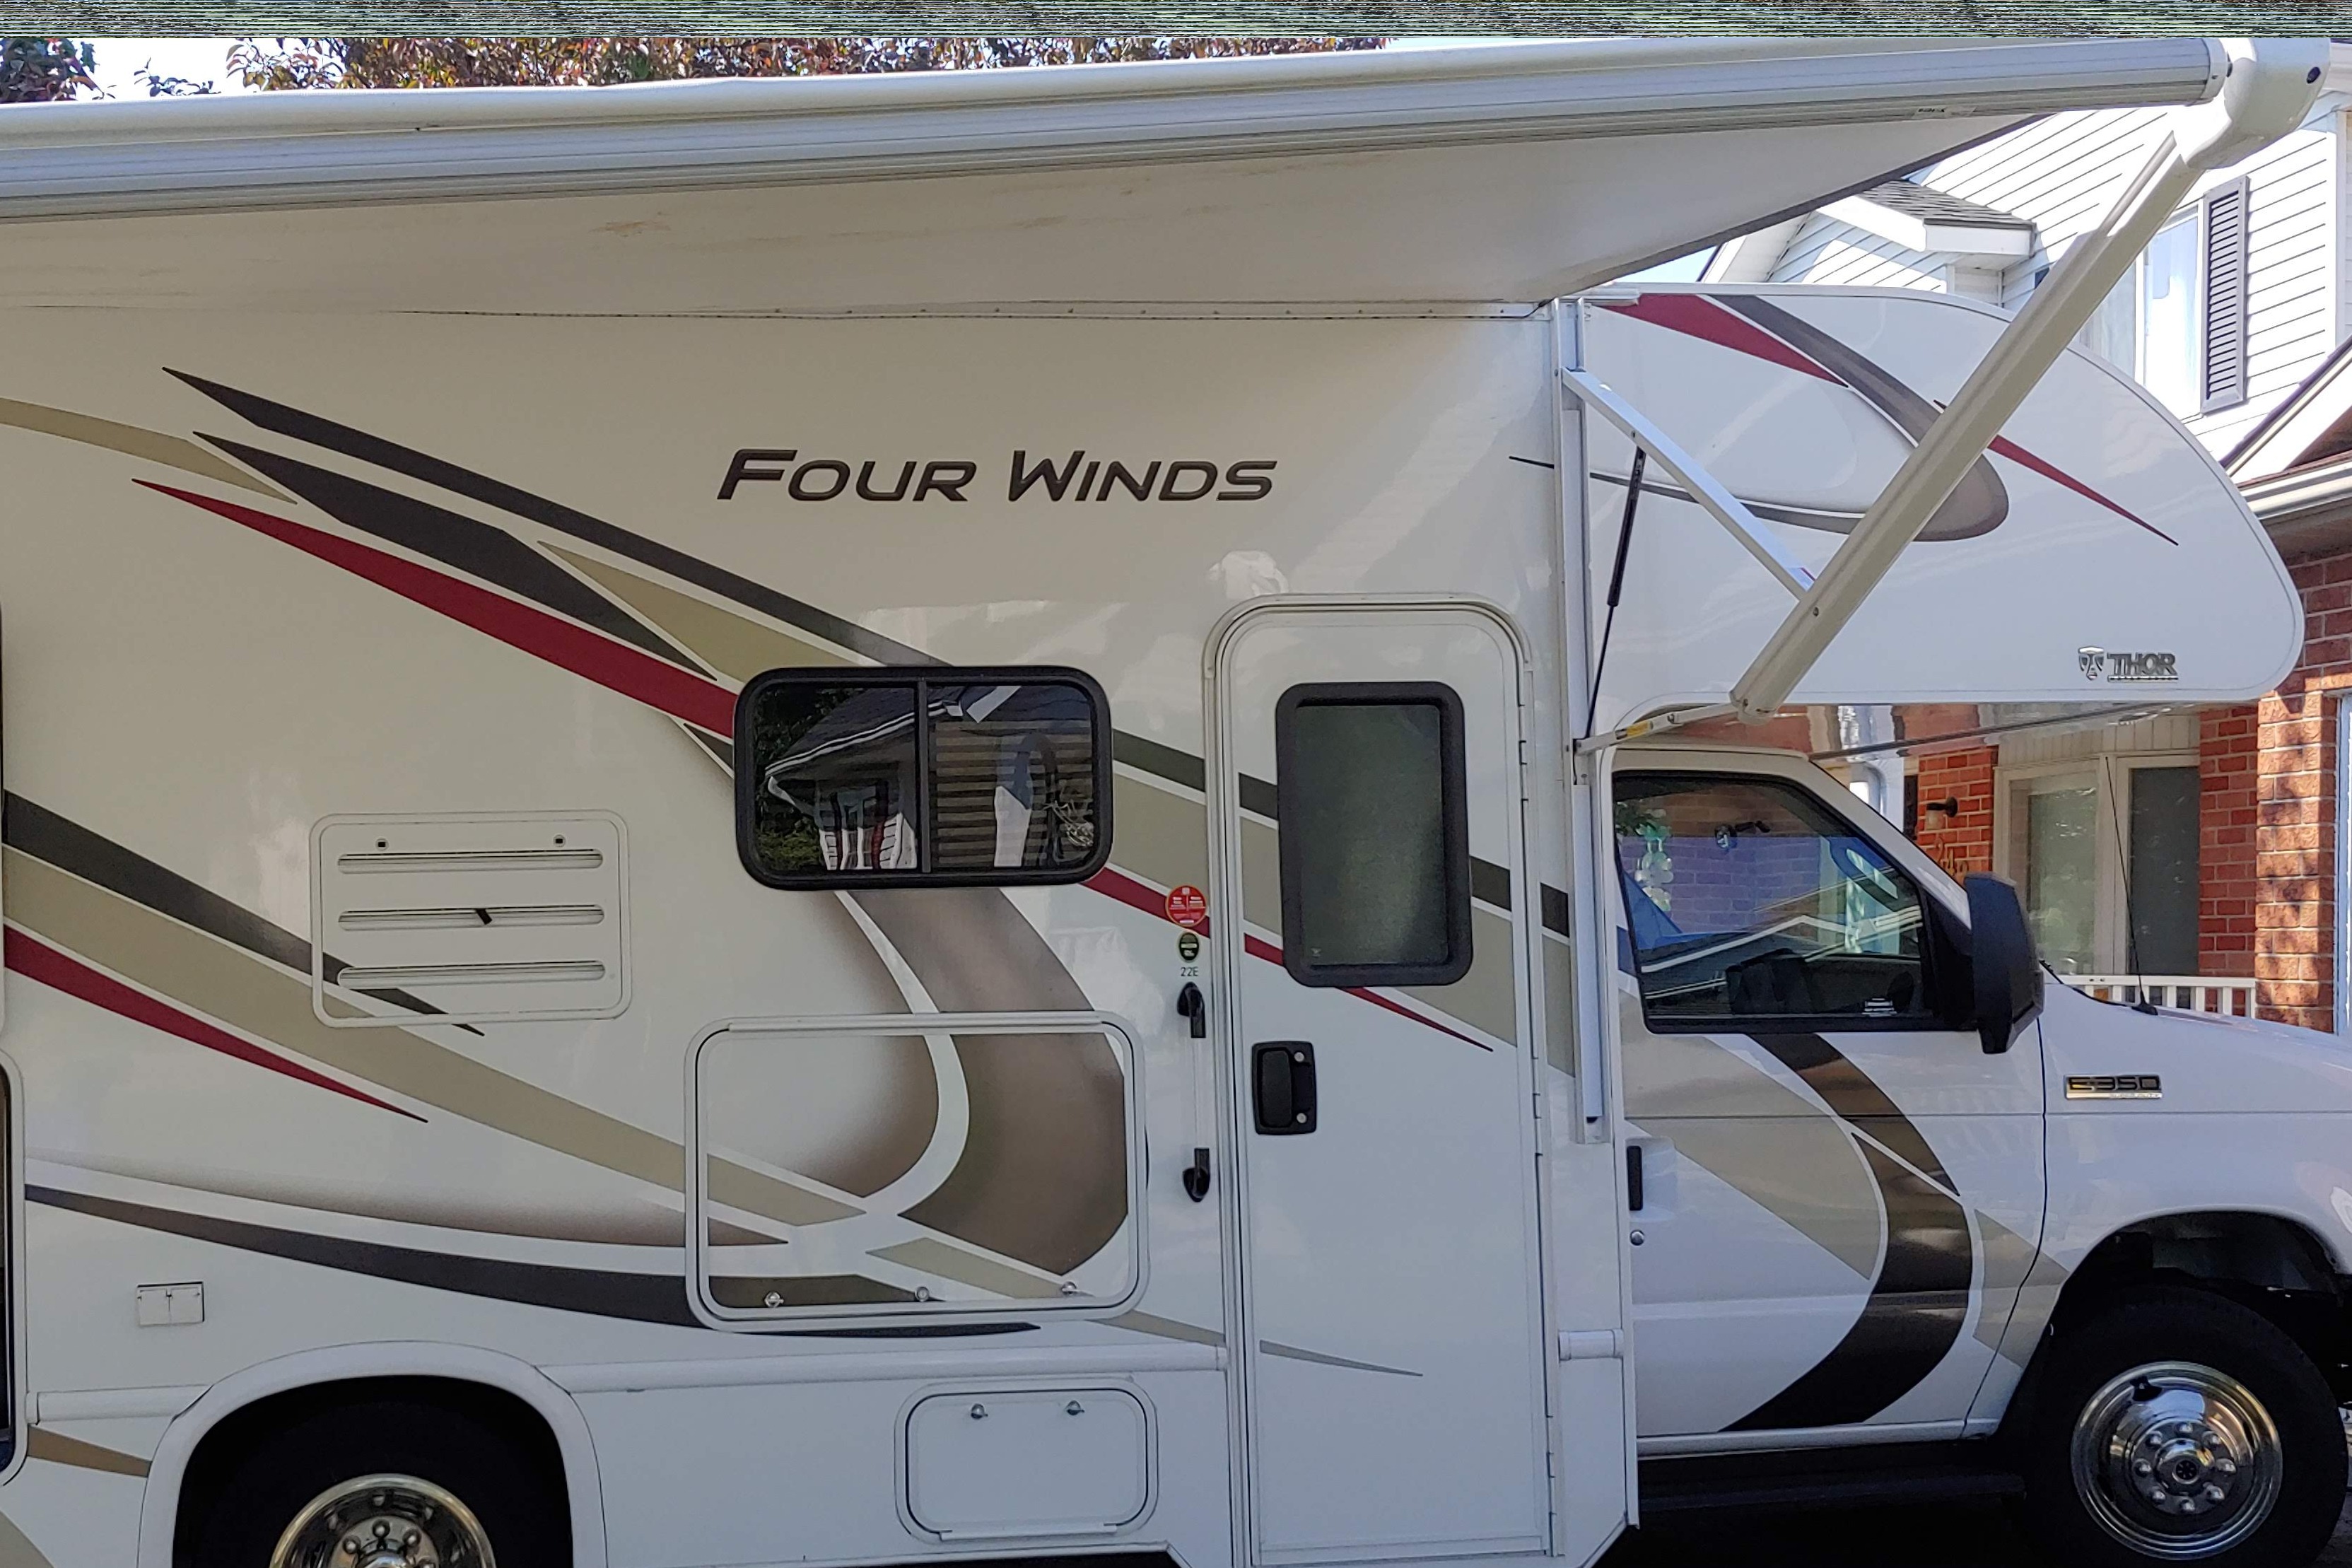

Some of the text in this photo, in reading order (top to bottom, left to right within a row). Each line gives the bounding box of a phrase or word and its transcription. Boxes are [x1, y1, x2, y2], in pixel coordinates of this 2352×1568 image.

[716, 448, 1278, 502] FOUR WINDS
[2107, 653, 2178, 676] THOR
[1181, 966, 1199, 977] 22E
